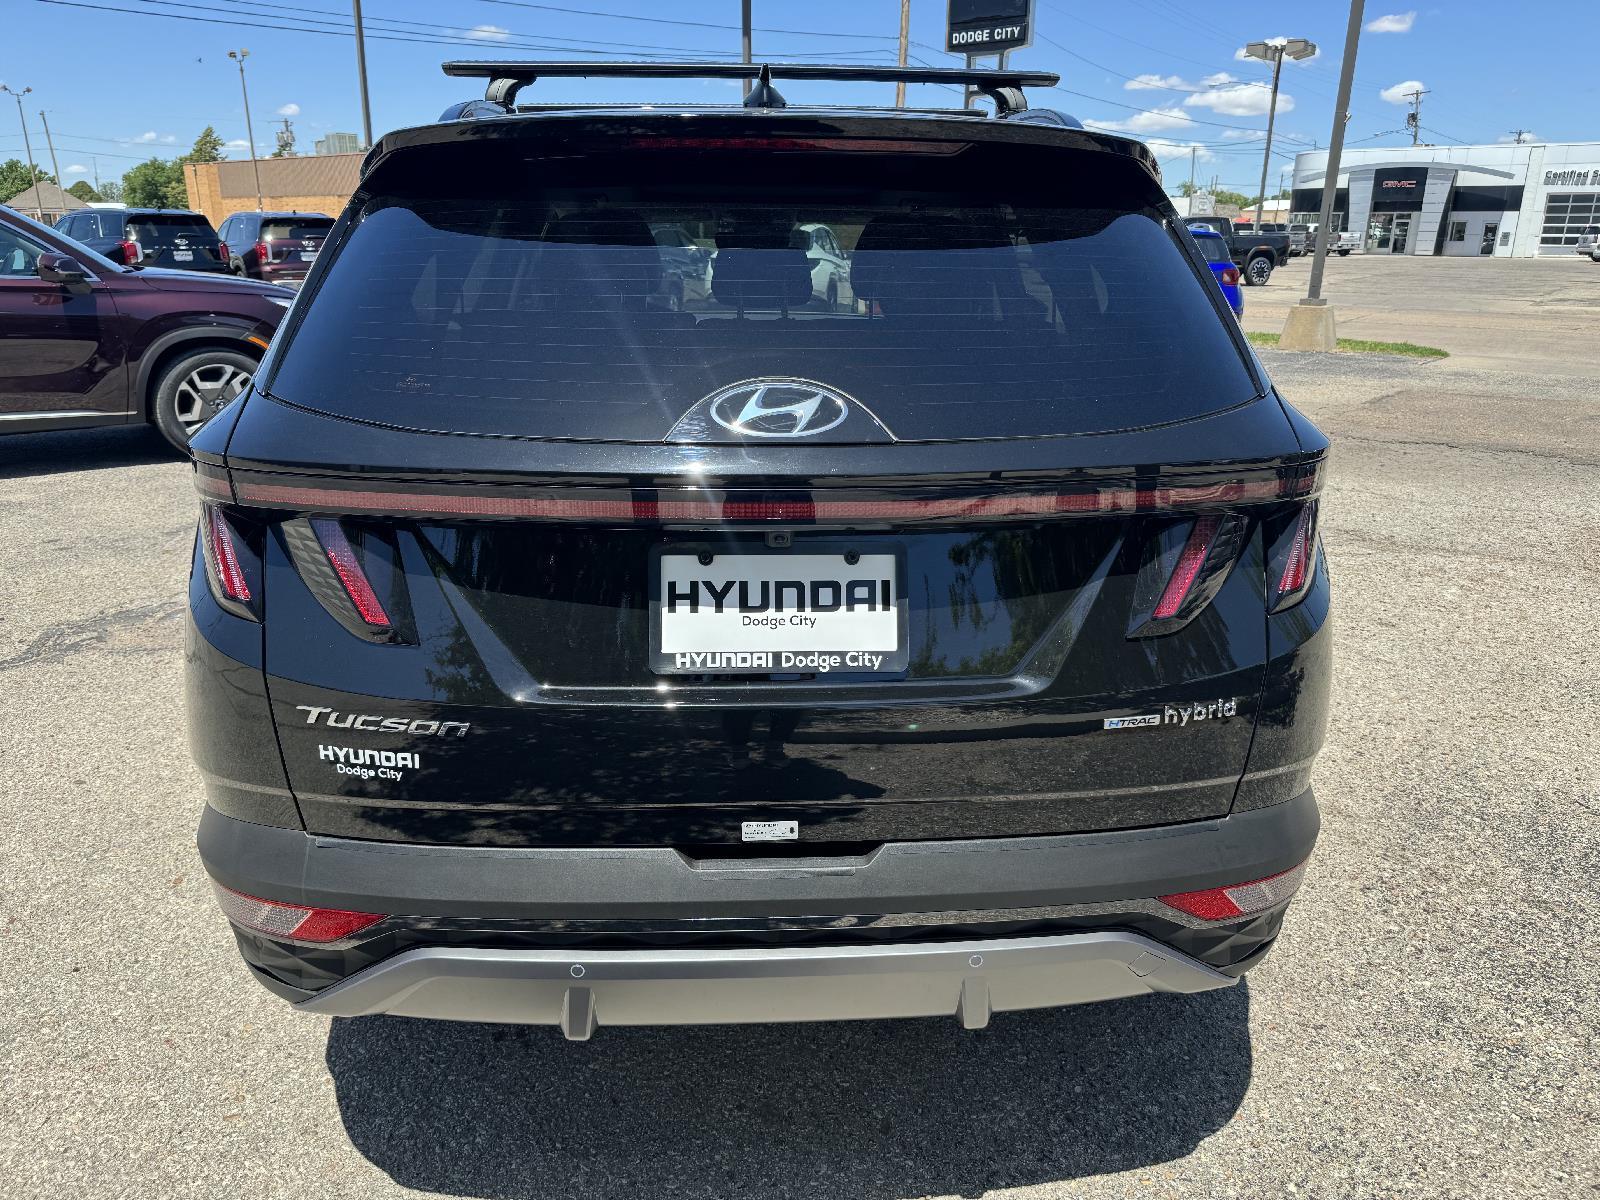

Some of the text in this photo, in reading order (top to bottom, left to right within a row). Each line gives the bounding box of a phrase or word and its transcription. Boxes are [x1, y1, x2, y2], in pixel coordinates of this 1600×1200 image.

[952, 26, 1021, 45] DODGE CITY
[1545, 169, 1590, 179] Certified
[1382, 180, 1417, 188] GMC
[667, 579, 891, 614] HYUNDAI
[742, 615, 817, 630] Dodge City
[675, 651, 883, 673] HYUNDAI Dodge City
[1107, 697, 1237, 729] HTRAC hybrid
[318, 744, 420, 769] HYUNDAI
[336, 763, 403, 782] Dodge City
